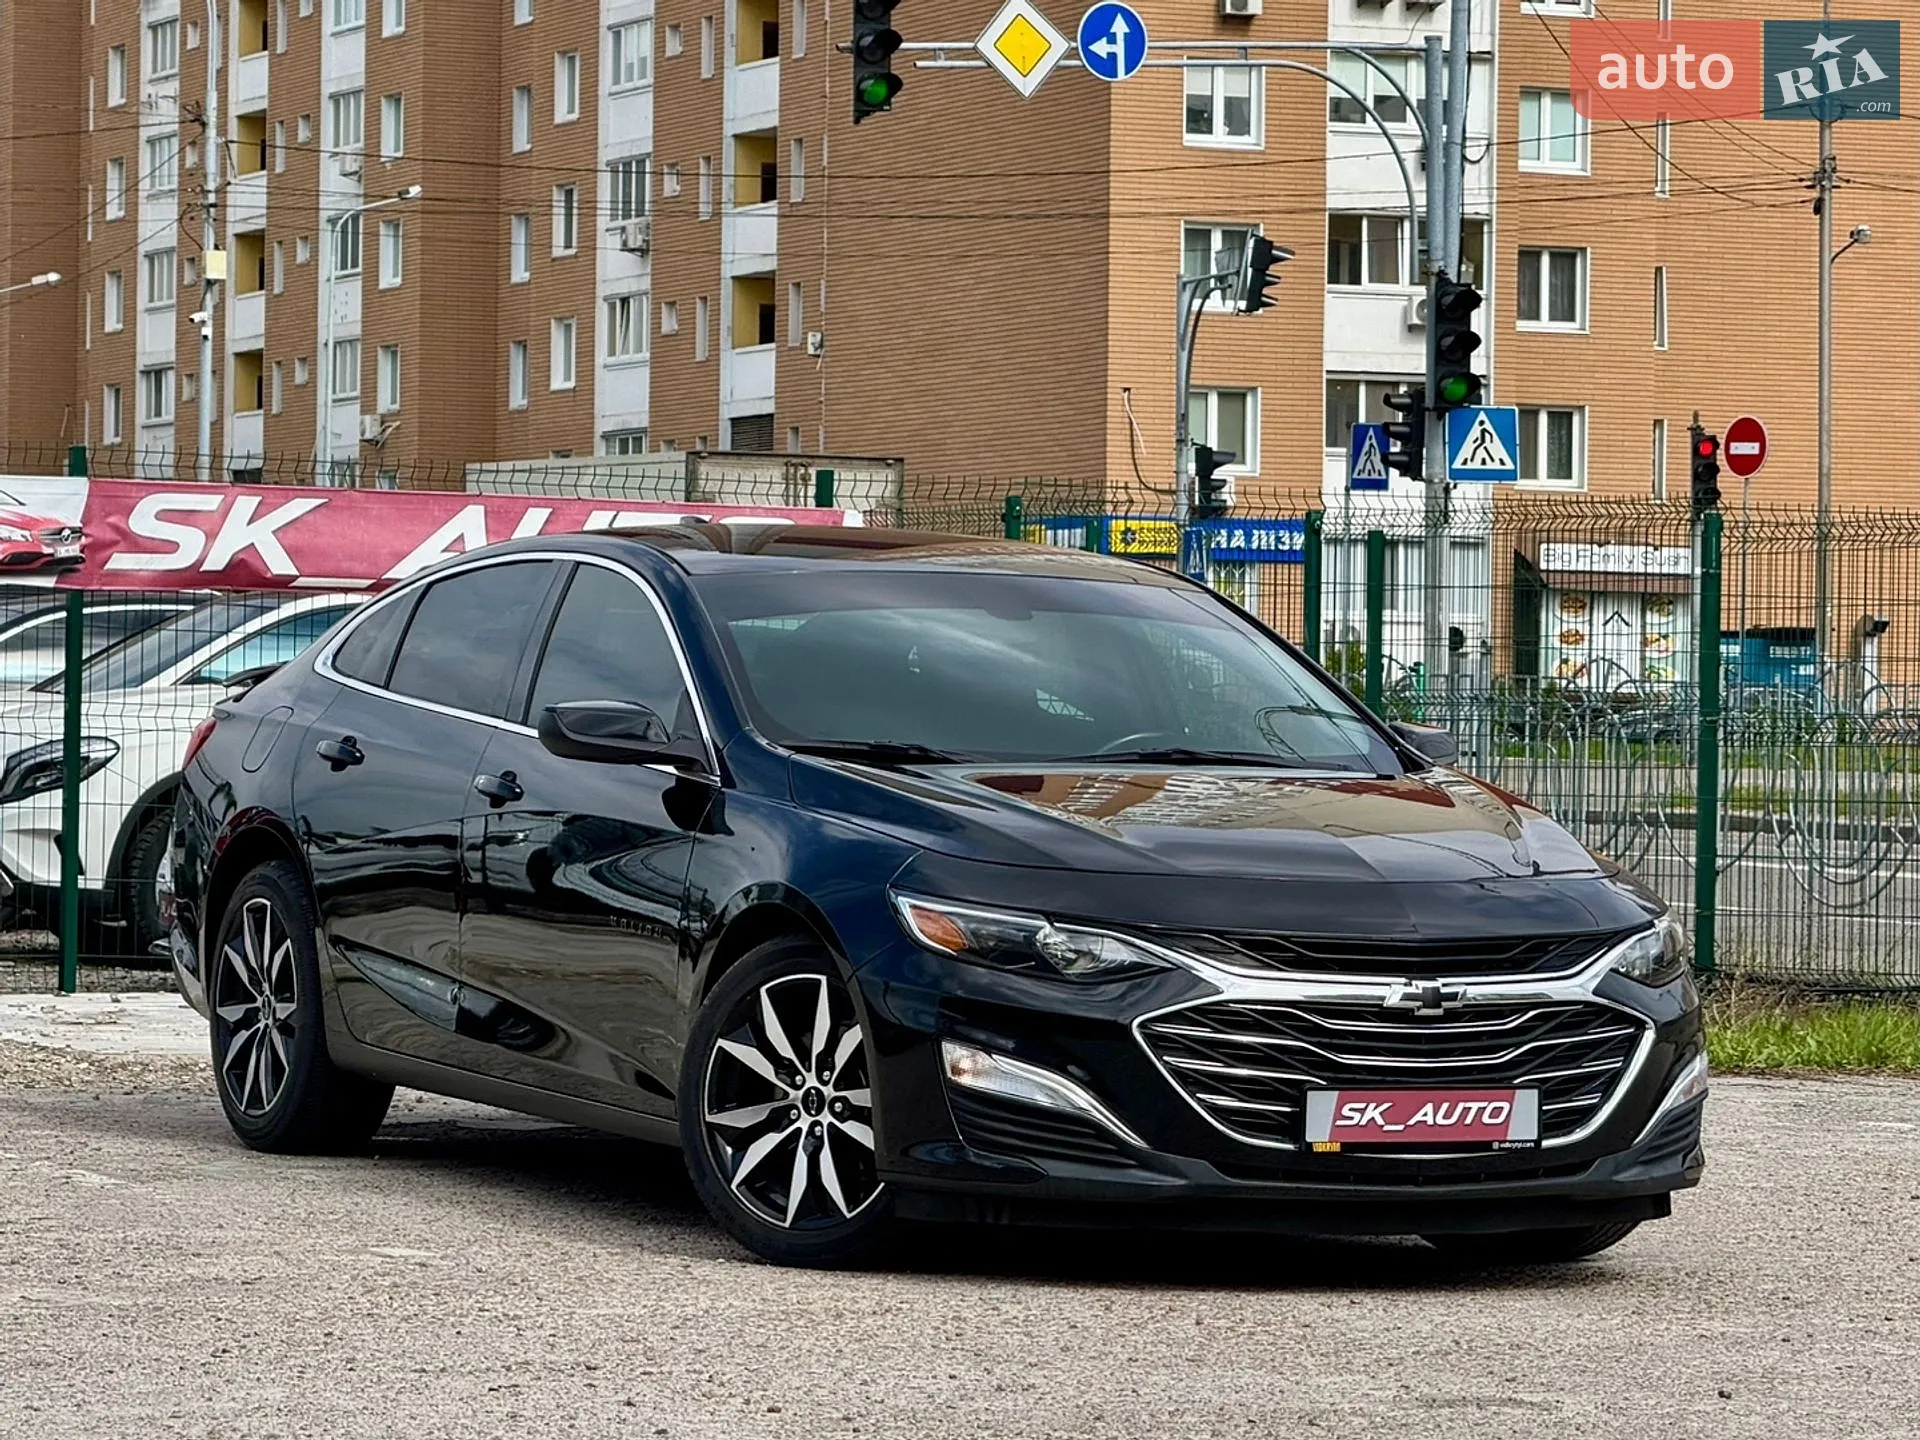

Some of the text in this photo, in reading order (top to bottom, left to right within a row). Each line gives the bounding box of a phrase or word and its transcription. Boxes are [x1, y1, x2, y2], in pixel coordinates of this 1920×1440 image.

[1543, 547, 1571, 567] Big
[1577, 548, 1635, 569] Family
[1335, 1101, 1511, 1131] SK_AUTO
